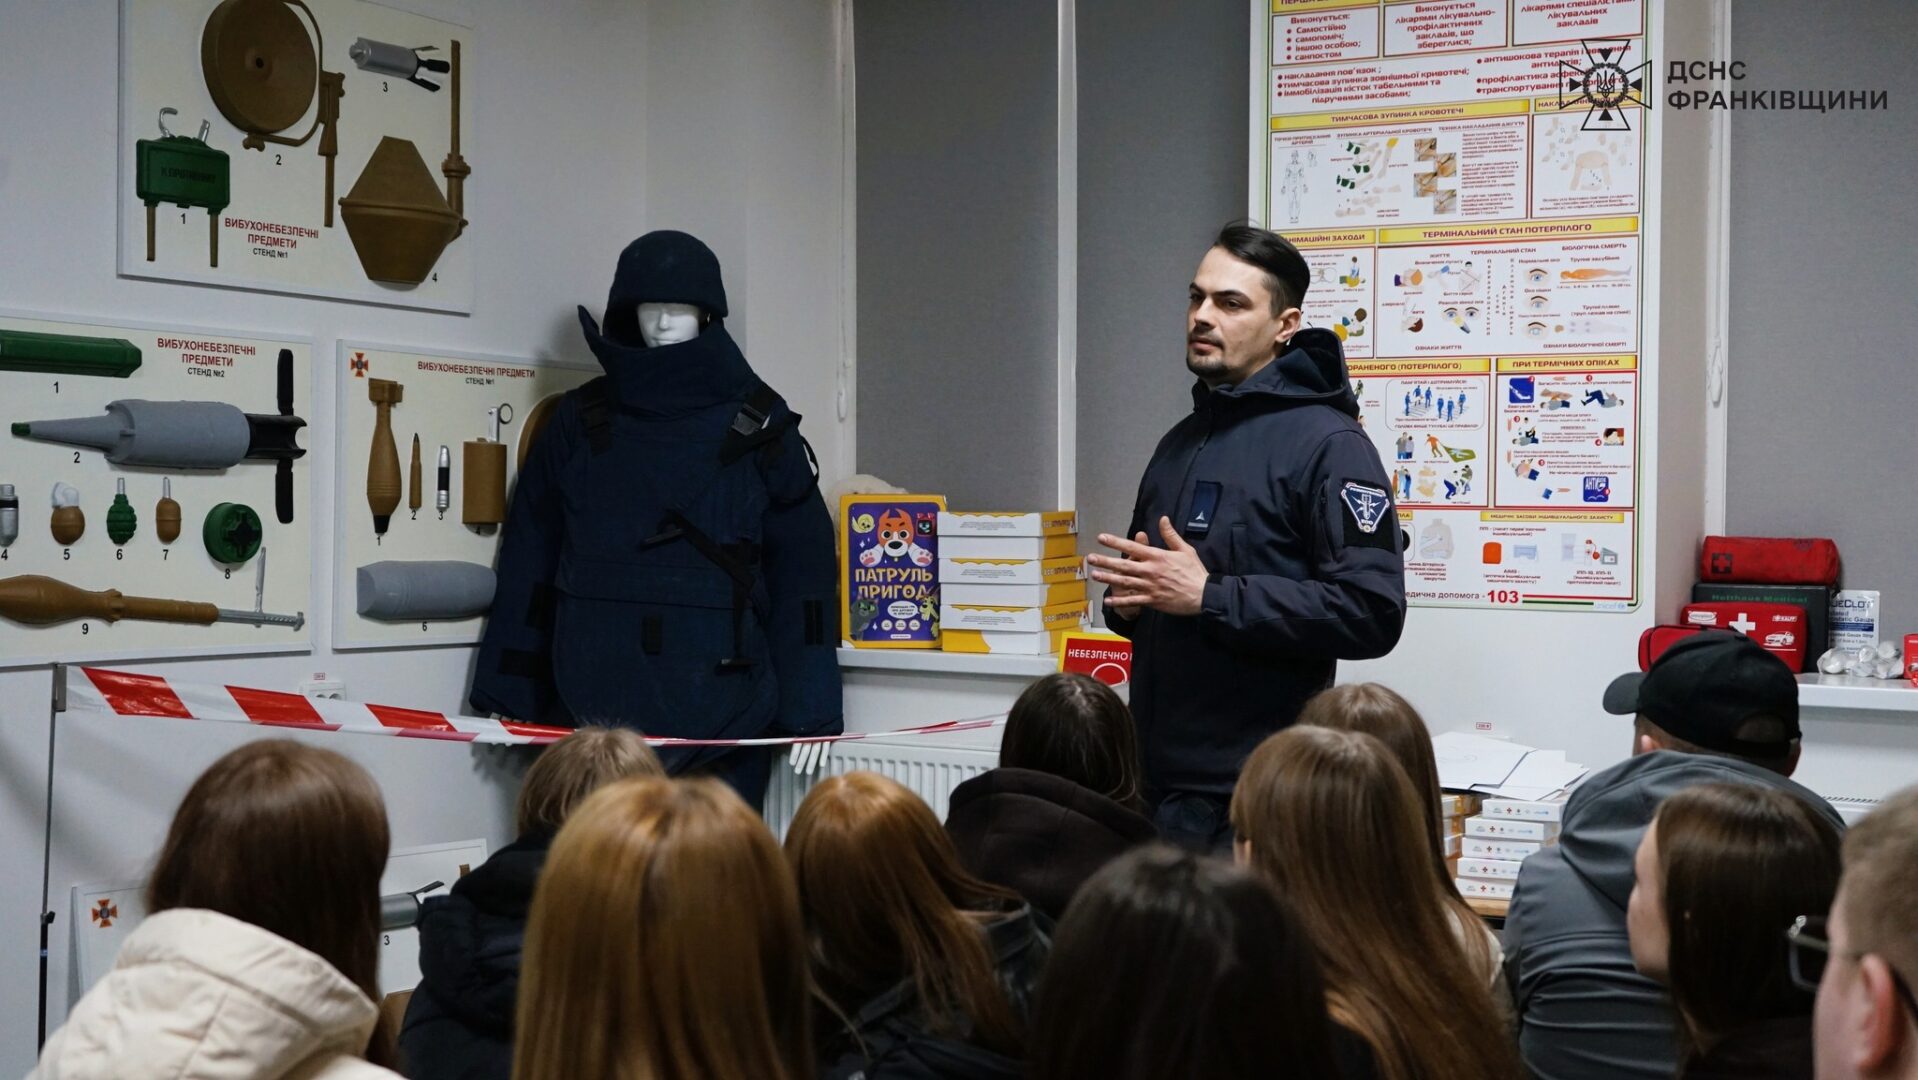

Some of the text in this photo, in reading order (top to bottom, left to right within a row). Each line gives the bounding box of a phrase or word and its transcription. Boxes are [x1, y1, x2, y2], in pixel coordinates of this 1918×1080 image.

[1415, 2, 1475, 13] Виконується
[1395, 13, 1438, 25] лікарями
[1547, 8, 1608, 20] лікувальних
[1556, 17, 1599, 28] закладів
[1295, 23, 1347, 35] Самостійно
[1295, 43, 1323, 53] іншою
[1294, 51, 1343, 61] санпостом
[1483, 53, 1542, 64] антишокова
[1543, 49, 1580, 61] терапія
[1284, 71, 1337, 81] накладання
[1482, 73, 1549, 86] профілактика
[382, 81, 389, 93] 3
[1283, 79, 1331, 90] тимчасова
[1331, 76, 1369, 88] зупинка
[1344, 84, 1371, 94] кісток
[1373, 79, 1429, 91] табельними
[1430, 78, 1441, 87] та
[1311, 94, 1363, 106] підручними
[1330, 107, 1464, 124] ТИМЧАСОВА ЗУПИНКА КРОВОТЕЧІ
[275, 154, 282, 166] 2
[181, 213, 187, 224] 1
[224, 216, 319, 239] ВИБУХОНЕБЕЗПЕЧНІ
[1422, 223, 1592, 239] ТЕРМІНАЛЬНИЙ СТАН ПОТЕРПІЛОГО
[247, 232, 298, 249] ПРЕДМЕТИ
[1284, 233, 1366, 244] АНІМАЦІЙНІ ЗАХОДИ
[252, 247, 289, 259] СТЕНД №1
[432, 272, 438, 284] 4
[157, 337, 257, 356] ВИБУХОНЕБЕЗПЕЧНІ
[182, 354, 235, 368] ПРЕДМЕТИ
[1347, 361, 1462, 373] ОРАНЕНОГО (ПОТЕРПІЛОГО)
[1511, 358, 1620, 371] ПРИ ТЕРМІЧНИХ ОПІКАХ
[187, 366, 226, 379] СТЕНД №2
[417, 360, 536, 379] ВИБУХОНЕБЕЗПЕЧНІ ПРЕДМЕТИ
[465, 376, 485, 387] СТЕНД
[53, 382, 59, 394] 1
[73, 451, 81, 464] 2
[411, 509, 444, 520] 2 3
[377, 535, 382, 546] 1
[1, 549, 169, 561] 4 5 6 7
[225, 568, 231, 581] 8
[855, 567, 934, 583] ПАТРУЛЬ
[858, 584, 930, 602] ПРИГОД
[1404, 591, 1437, 600] едична
[1437, 593, 1480, 602] допомога
[1487, 589, 1521, 604] 103
[82, 623, 89, 636] 9
[422, 621, 428, 632] 6
[1067, 648, 1129, 662] НЕБЕЗПЕЧНО
[383, 934, 390, 946] 3
